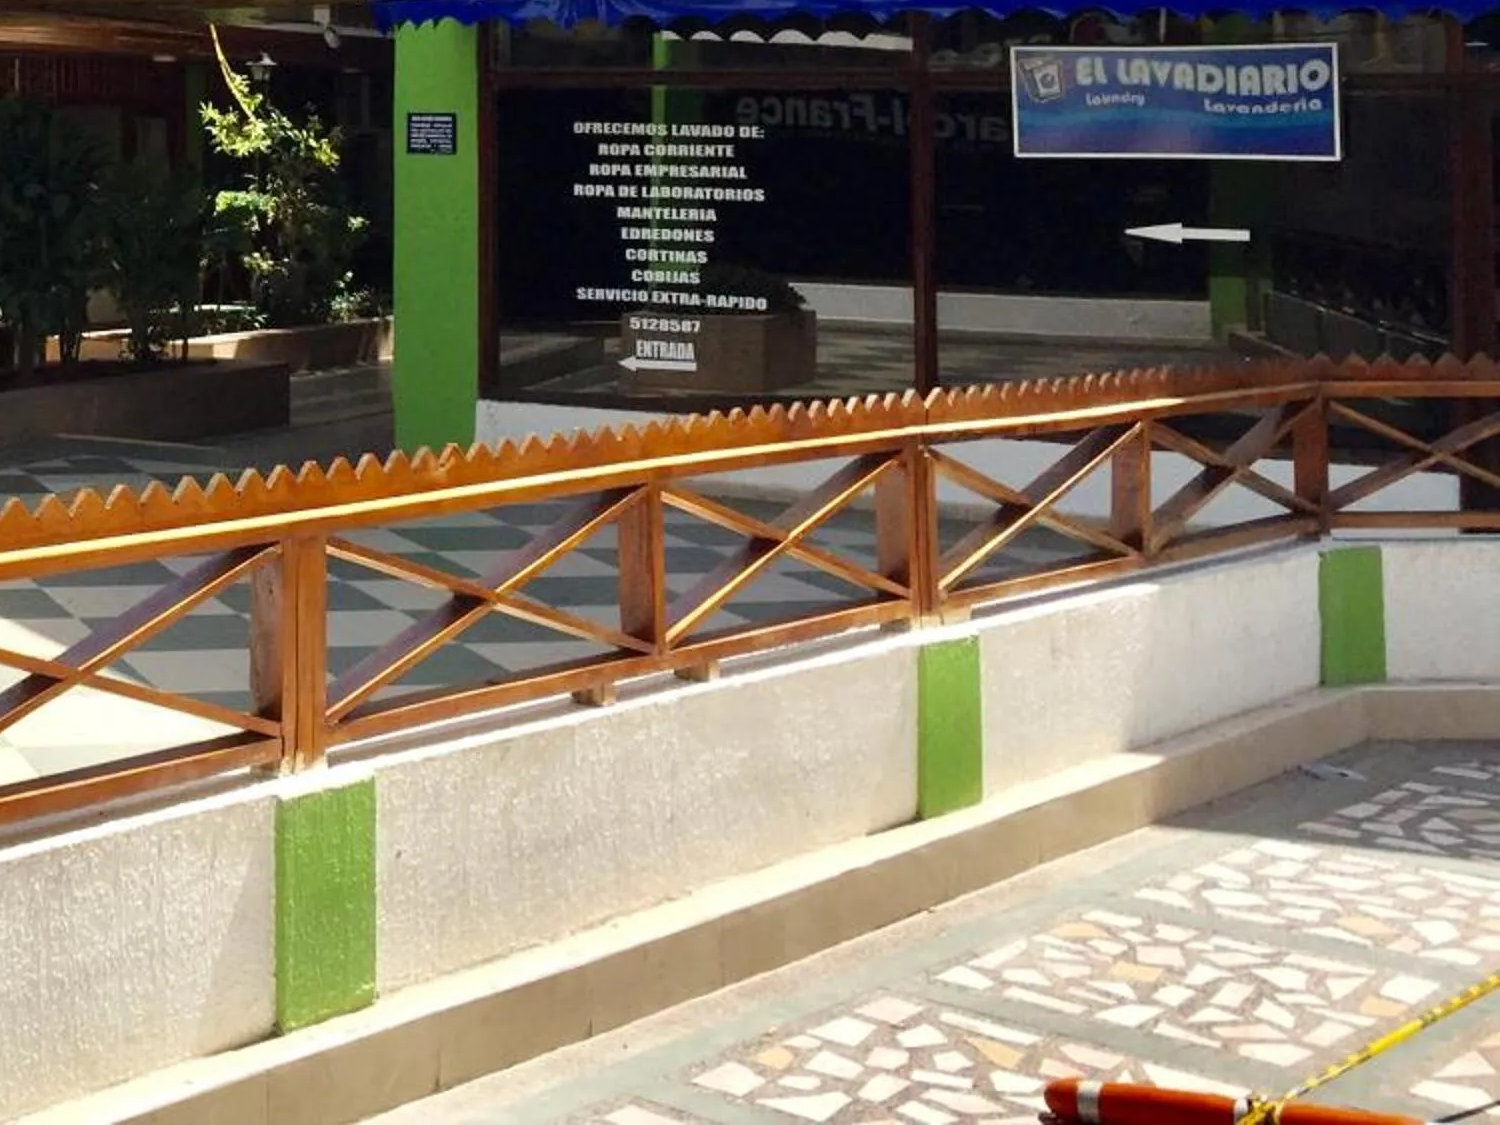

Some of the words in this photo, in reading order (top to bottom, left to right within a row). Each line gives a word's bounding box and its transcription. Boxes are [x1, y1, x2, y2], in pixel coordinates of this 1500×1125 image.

[1076, 56, 1109, 86] EL
[1117, 58, 1331, 97] LAVADIARIO
[573, 121, 668, 136] OFRECEMOS
[671, 125, 735, 138] LAVADO
[739, 126, 765, 139] DE:
[598, 143, 641, 156] ROPA
[643, 144, 735, 158] CORRIENTE
[589, 163, 632, 176] ROPA
[634, 164, 748, 180] EMPRESARIAL
[573, 183, 615, 197] ROPA
[618, 186, 638, 198] DE
[641, 186, 765, 202] LABORATORIOS
[617, 206, 718, 221] MANTELERIA
[621, 227, 715, 243] EDREDONES
[625, 248, 709, 264] CORTINAS
[631, 269, 701, 284] COBIJAS
[576, 287, 649, 302] SERVICIO
[651, 290, 768, 311] EXTRA-RAPIDO
[636, 340, 695, 360] ENTRADA
